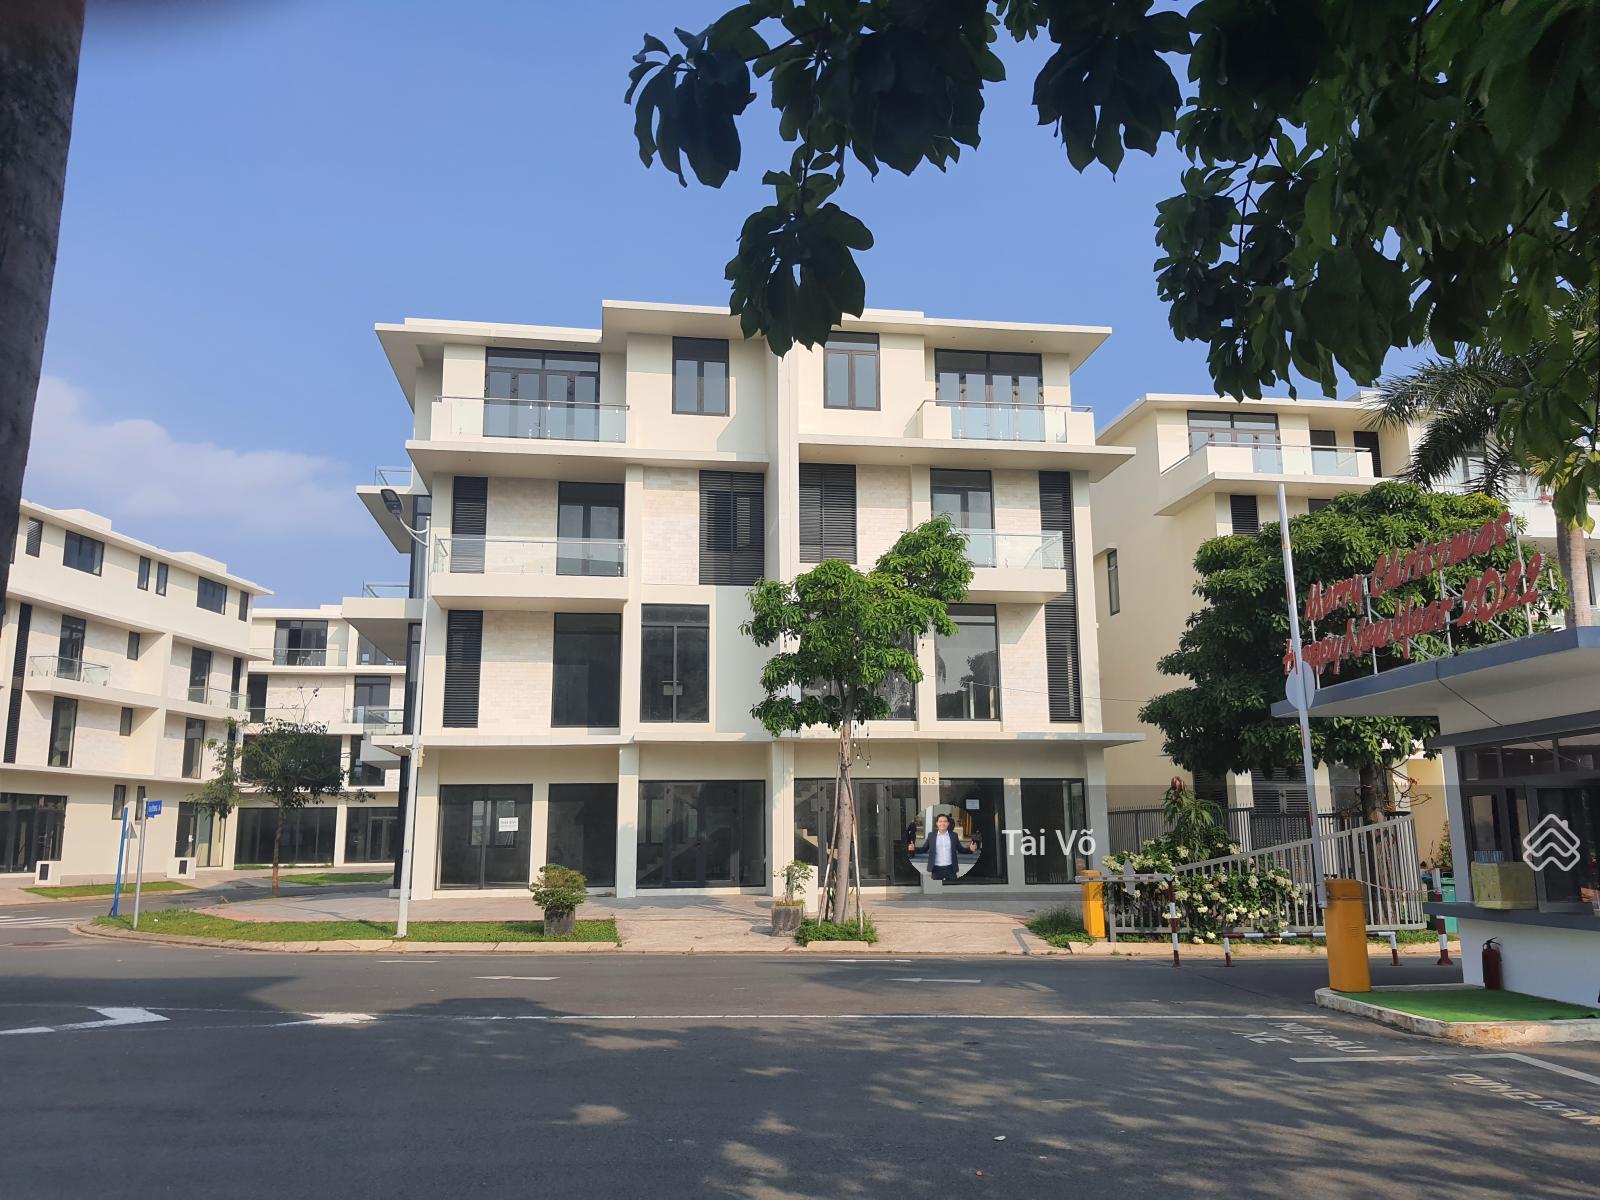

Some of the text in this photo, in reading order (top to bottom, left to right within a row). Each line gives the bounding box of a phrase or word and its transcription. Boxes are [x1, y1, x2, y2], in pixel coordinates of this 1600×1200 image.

[1305, 511, 1511, 621] Merry Christmas
[1393, 595, 1455, 661] Year
[1457, 552, 1544, 628] 2022
[922, 776, 937, 785] R15
